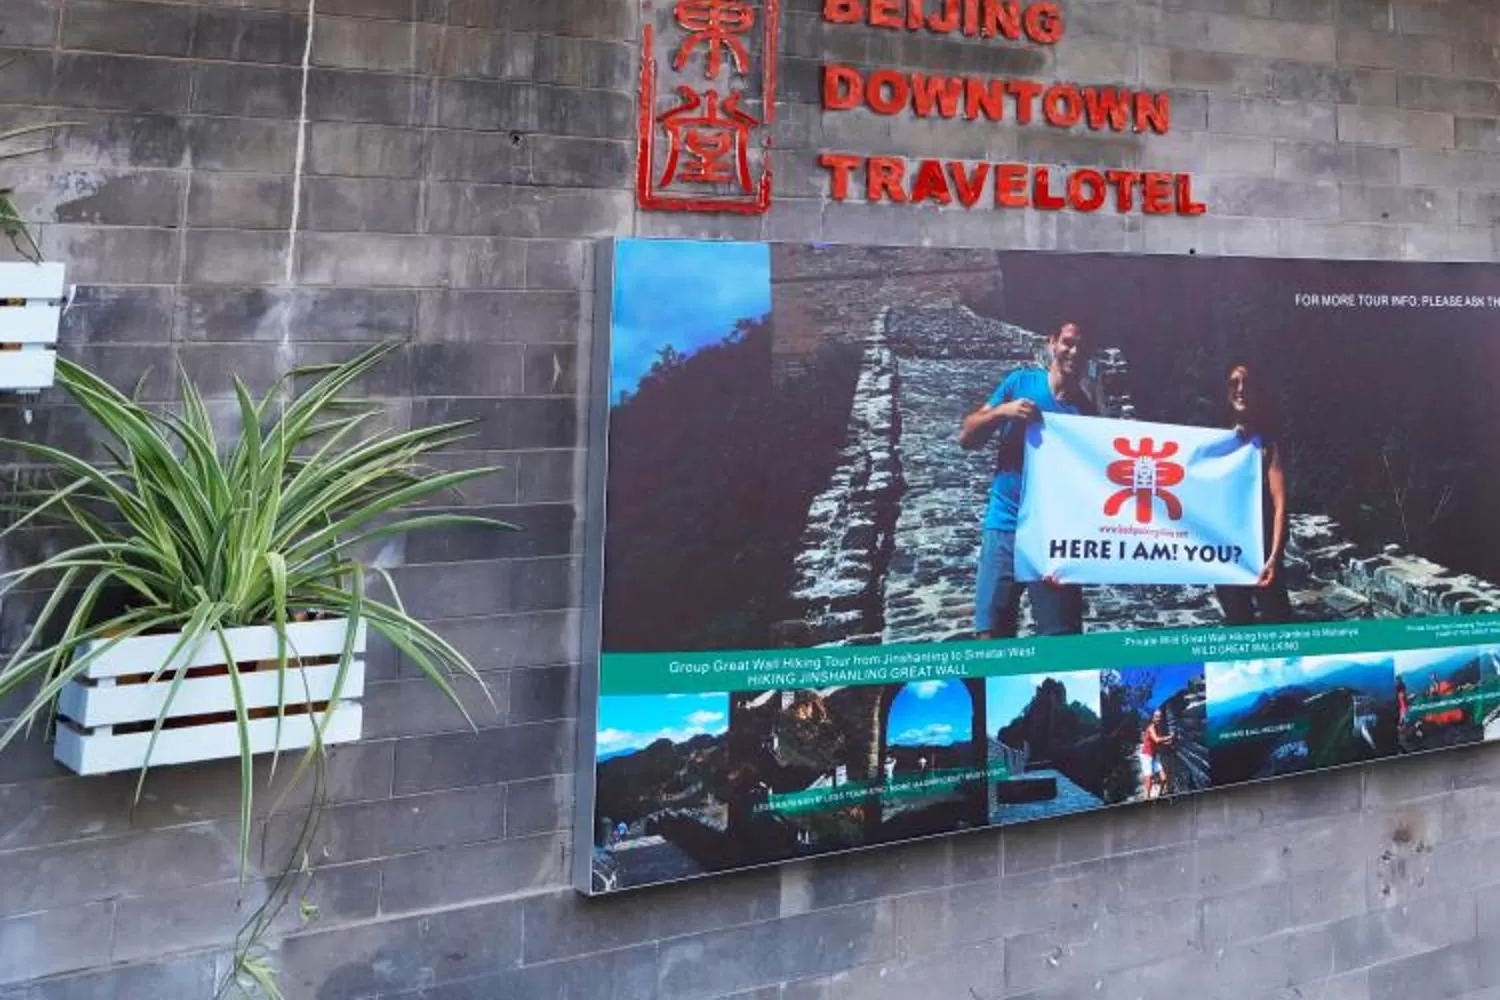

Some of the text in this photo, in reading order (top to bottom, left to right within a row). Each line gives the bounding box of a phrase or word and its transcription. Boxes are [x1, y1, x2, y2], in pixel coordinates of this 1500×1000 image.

[822, 66, 1171, 134] DOWNTOWN
[821, 153, 1207, 215] TRAVELOTEL
[1295, 293, 1319, 307] FOR
[1322, 293, 1356, 307] MORE
[1358, 293, 1389, 307] TOUR
[1422, 295, 1463, 307] PLEASE
[1465, 295, 1485, 307] ASK
[1050, 539, 1242, 563] HERE I AM! YOU?
[669, 660, 711, 675] Group
[713, 659, 749, 672] Great
[751, 657, 779, 671] Wall
[782, 656, 821, 671] Hiking
[825, 655, 850, 668] Tour
[853, 653, 881, 666] from
[883, 650, 949, 665] Jinshanling
[951, 650, 962, 662] to
[1007, 646, 1036, 658] West
[747, 663, 969, 687] HIKING JINSHANLING GREAT WALL
